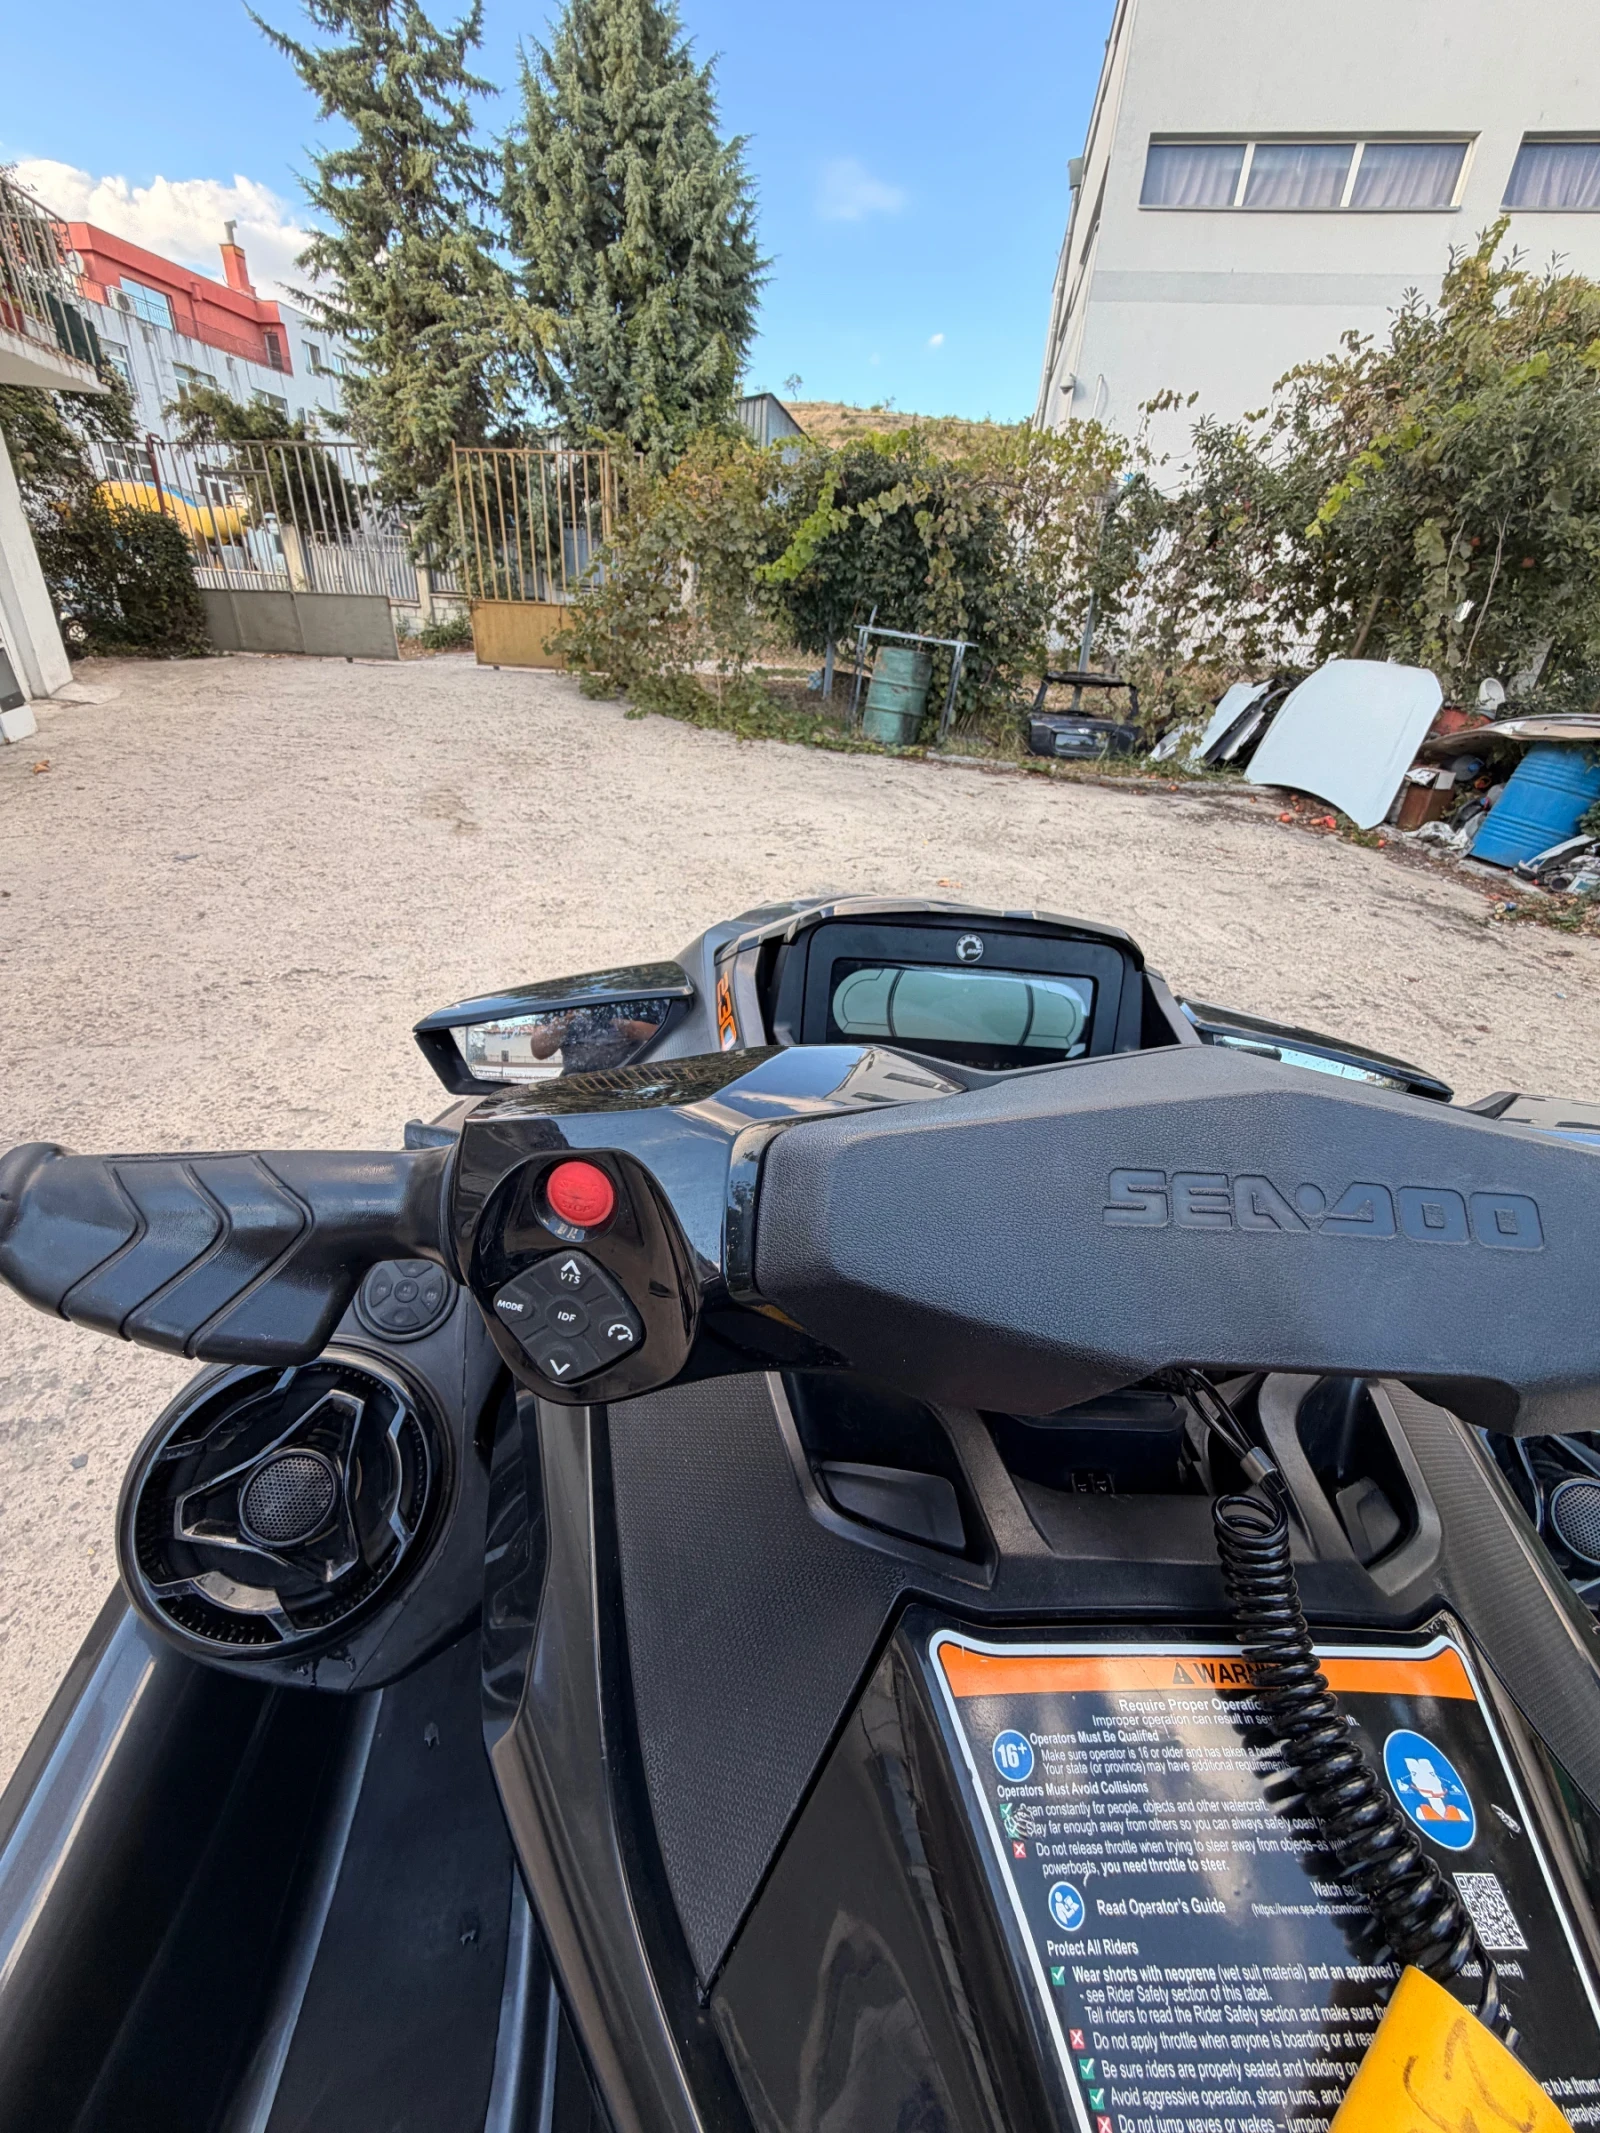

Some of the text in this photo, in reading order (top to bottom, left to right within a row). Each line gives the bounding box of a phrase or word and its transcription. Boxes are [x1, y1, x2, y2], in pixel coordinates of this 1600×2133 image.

[717, 971, 737, 1052] 230
[560, 1272, 581, 1285] VTS
[497, 1299, 524, 1312] MODE
[557, 1311, 576, 1322] IDF
[1119, 1699, 1166, 1715] Require
[1169, 1698, 1209, 1714] Proper
[1092, 1714, 1140, 1728] Improper
[1142, 1714, 1191, 1728] operation
[1192, 1715, 1212, 1725] can
[1214, 1712, 1243, 1725] result
[1242, 1712, 1254, 1724] in
[1030, 1729, 1160, 1748] Operators Must Be Qualified
[1041, 1749, 1067, 1762] Make
[1069, 1750, 1088, 1761] sure
[1090, 1748, 1128, 1763] operator
[1128, 1747, 1137, 1759] is
[1139, 1746, 1150, 1759] 16
[1151, 1748, 1161, 1759] or
[1162, 1746, 1185, 1759] older
[1186, 1745, 1203, 1758] and
[1203, 1744, 1222, 1758] has
[1221, 1744, 1247, 1758] taken
[1043, 1762, 1066, 1776] Your
[1066, 1762, 1088, 1774] state
[1104, 1760, 1147, 1776] province)
[1147, 1762, 1169, 1775] may
[1167, 1760, 1191, 1773] have
[1191, 1759, 1235, 1772] additional
[997, 1780, 1150, 1800] Operators Must Avoid Collisions
[1045, 1802, 1091, 1818] constantly
[1092, 1800, 1107, 1815] for
[1143, 1799, 1176, 1816] objects
[1177, 1798, 1195, 1812] and
[1196, 1798, 1220, 1813] other
[1049, 1820, 1063, 1834] far
[1063, 1818, 1098, 1836] enough
[1100, 1820, 1124, 1835] away
[1126, 1818, 1147, 1832] from
[1148, 1817, 1179, 1832] others
[1180, 1819, 1192, 1831] so
[1192, 1819, 1212, 1833] you
[1213, 1818, 1230, 1831] can
[1231, 1816, 1264, 1833] always
[1264, 1815, 1292, 1833] safely
[1036, 1842, 1051, 1857] Do
[1052, 1842, 1068, 1856] not
[1069, 1841, 1103, 1855] release
[1104, 1840, 1138, 1854] throttle
[1138, 1839, 1165, 1853] when
[1166, 1838, 1193, 1856] trying
[1194, 1838, 1204, 1852] to
[1206, 1839, 1230, 1853] steer
[1231, 1839, 1256, 1855] away
[1256, 1836, 1281, 1852] from
[1101, 1860, 1121, 1878] you
[1122, 1858, 1148, 1873] need
[1148, 1857, 1187, 1873] throttle
[1188, 1858, 1199, 1873] to
[1309, 1881, 1343, 1898] Watch
[1096, 1899, 1127, 1916] Read
[1190, 1896, 1226, 1915] Guide
[1047, 1938, 1139, 1956] Protect All Riders
[1073, 1966, 1101, 1983] Wear
[1104, 1966, 1139, 1983] shorts
[1141, 1965, 1163, 1983] with
[1165, 1966, 1217, 1985] neoprene
[1243, 1965, 1262, 1983] suit
[1309, 1962, 1329, 1982] and
[1331, 1964, 1345, 1981] an
[1346, 1962, 1396, 1985] approved
[1087, 1989, 1106, 2004] see
[1107, 1986, 1135, 2003] Rider
[1137, 1985, 1170, 2007] Safety
[1172, 1985, 1210, 2004] section
[1211, 1984, 1222, 2003] of
[1221, 1984, 1243, 2002] this
[1085, 2006, 1105, 2024] Tell
[1106, 2006, 1137, 2024] riders
[1137, 2007, 1149, 2023] to
[1150, 2005, 1173, 2023] read
[1174, 2005, 1193, 2023] the
[1193, 2005, 1222, 2023] Rider
[1224, 2004, 1259, 2027] Safety
[1261, 2004, 1299, 2023] section
[1300, 2004, 1321, 2023] and
[1321, 2003, 1350, 2022] make
[1351, 2006, 1375, 2022] sure
[1093, 2029, 1357, 2054] Do not apply throttle when anyone is boarding or at
[1102, 2060, 1118, 2079] Be
[1120, 2063, 1145, 2079] sure
[1146, 2059, 1176, 2079] riders
[1178, 2063, 1198, 2079] are
[1198, 2058, 1242, 2083] properly
[1244, 2059, 1283, 2079] seated
[1283, 2057, 1305, 2078] and
[1304, 2057, 1346, 2082] holding
[1112, 2086, 1140, 2107] Avoid
[1143, 2086, 1200, 2112] aggressive
[1257, 2086, 1289, 2110] sharp
[1321, 2085, 1343, 2105] and
[1118, 2114, 1137, 2133] Do
[1138, 2115, 1158, 2133] not
[1185, 2118, 1223, 2133] waves
[1237, 2114, 1277, 2133] wakes
